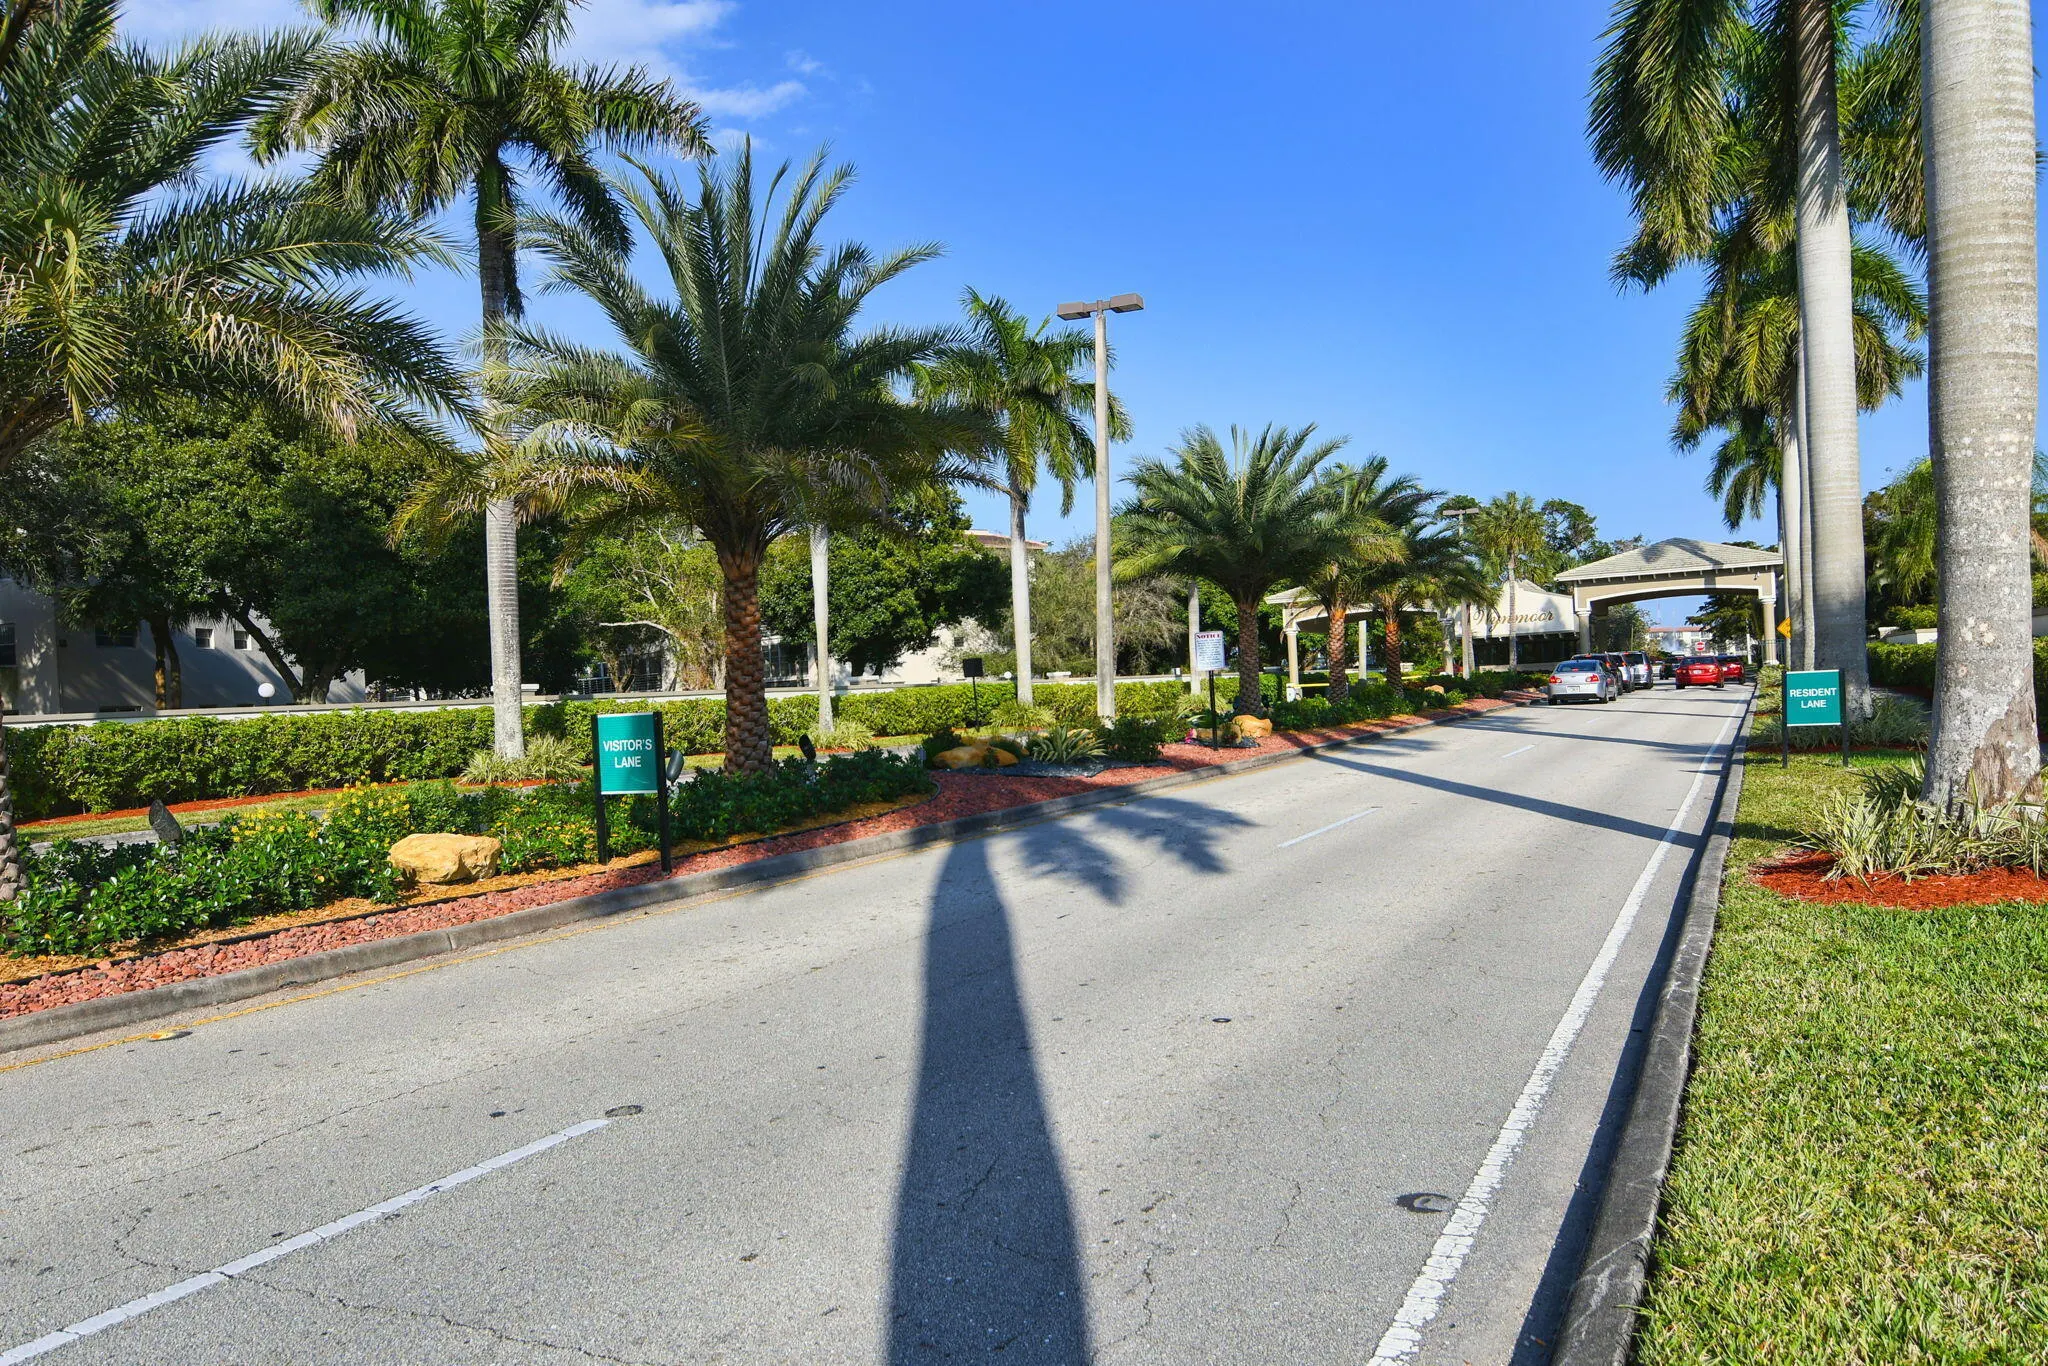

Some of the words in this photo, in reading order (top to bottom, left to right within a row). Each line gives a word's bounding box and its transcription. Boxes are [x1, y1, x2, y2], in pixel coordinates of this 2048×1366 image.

[1789, 687, 1837, 697] RESIDENT
[1801, 700, 1827, 708] LANE
[603, 739, 653, 752] VISITOR'S
[614, 756, 642, 768] LANE
